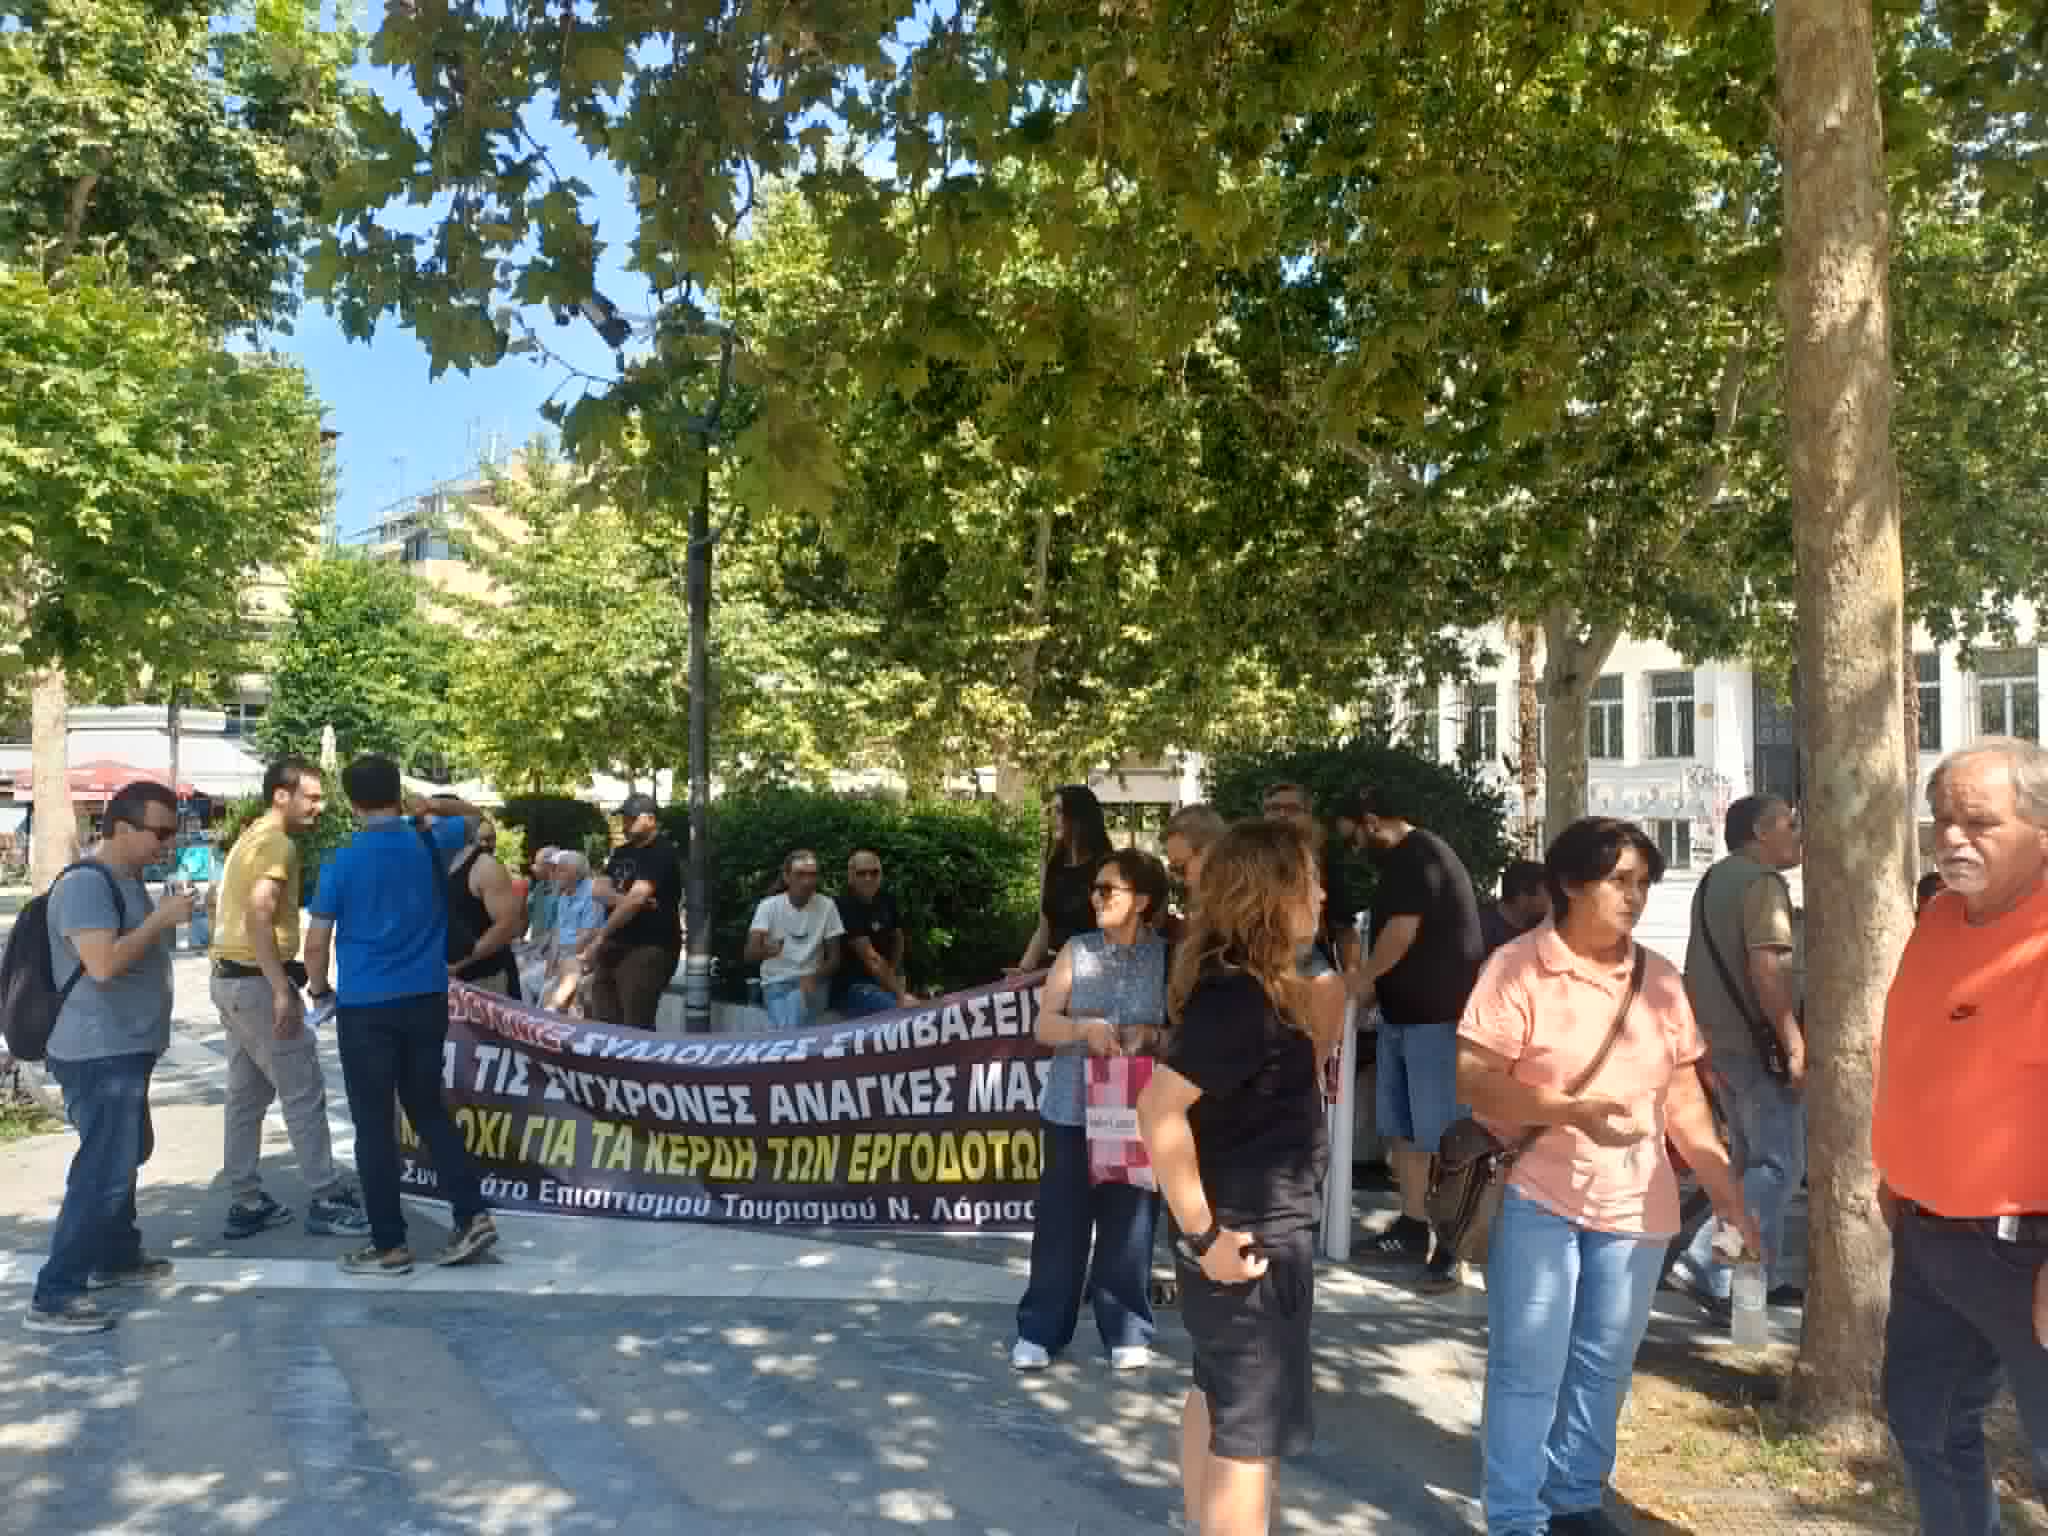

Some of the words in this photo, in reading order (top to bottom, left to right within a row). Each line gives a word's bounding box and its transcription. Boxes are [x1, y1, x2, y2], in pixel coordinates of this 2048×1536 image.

[473, 1045, 530, 1097] ΤΙΣ
[540, 1062, 757, 1124] ΣΥΓΧΡΟΝΕΣ
[769, 1065, 957, 1124] ΑΝΑΓΚΕΣ
[519, 1115, 576, 1168] ΓΙΑ
[592, 1121, 634, 1173] ΤΑ
[643, 1130, 758, 1180] ΚΕΡΔΗ
[768, 1135, 841, 1184] ΤΩΝ
[848, 1128, 1045, 1184] ΕΡΓΟΔΟΤΩ
[538, 1179, 711, 1218] Επισιτισμού
[720, 1193, 876, 1225] Τουρισμού
[888, 1196, 920, 1221] Ν.
